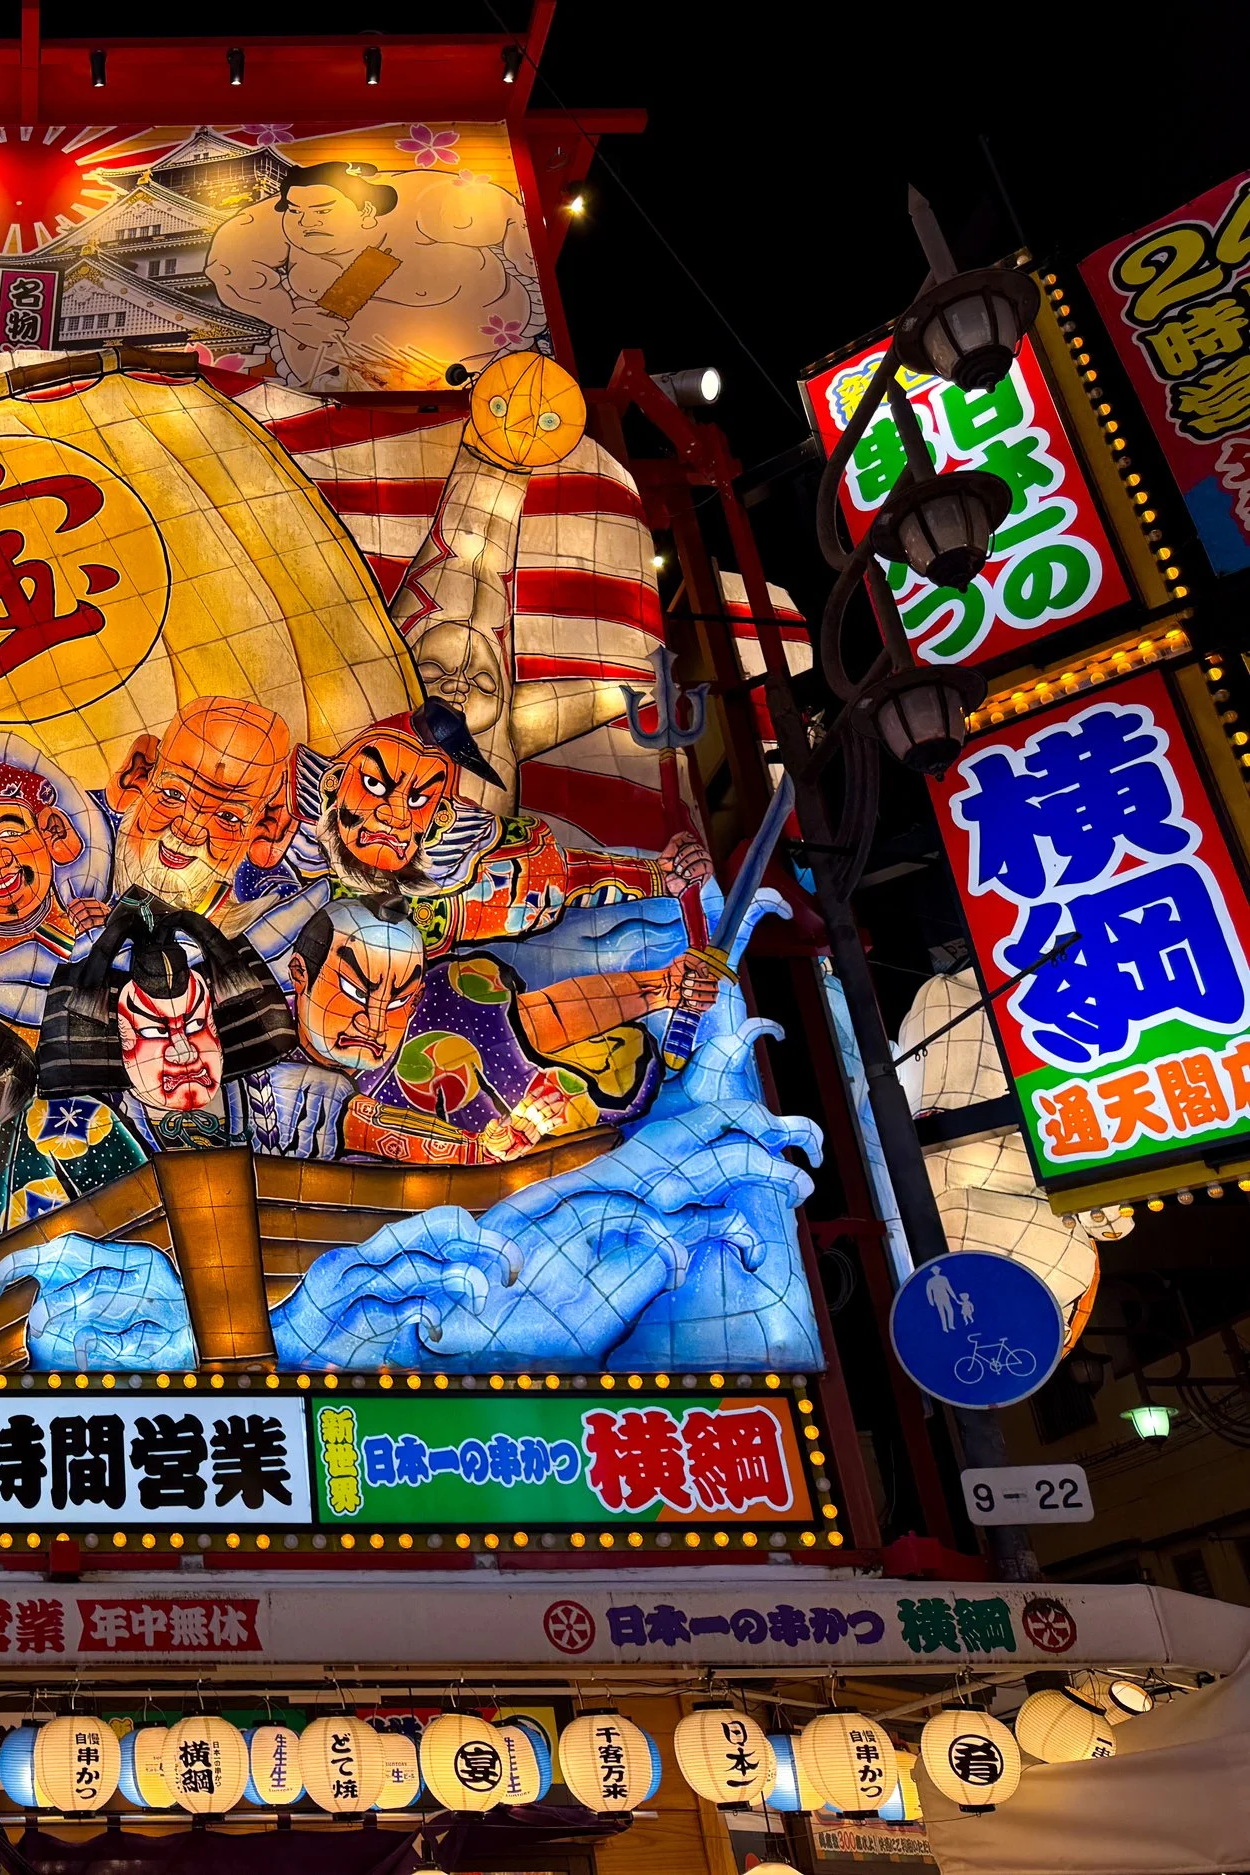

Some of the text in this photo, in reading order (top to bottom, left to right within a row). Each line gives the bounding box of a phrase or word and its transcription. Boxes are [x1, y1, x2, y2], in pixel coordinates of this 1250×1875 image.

[1, 277, 44, 351] 名物
[956, 707, 1248, 1068] 横綱
[318, 1408, 362, 1514] 新世界
[363, 1408, 792, 1511] 日本一の串かつ 横綱
[90, 1604, 250, 1648] 年中無休
[606, 1598, 1017, 1653] 日本一の串かつ 横綱
[75, 1747, 100, 1799] 串かつ
[179, 1740, 214, 1794] 横綱
[270, 1734, 287, 1787] 生生生
[331, 1732, 358, 1799] どて焼
[458, 1745, 500, 1789] 宴
[596, 1727, 628, 1800] 千客万来
[721, 1720, 761, 1788] 日本一
[856, 1745, 884, 1798] 串かつ
